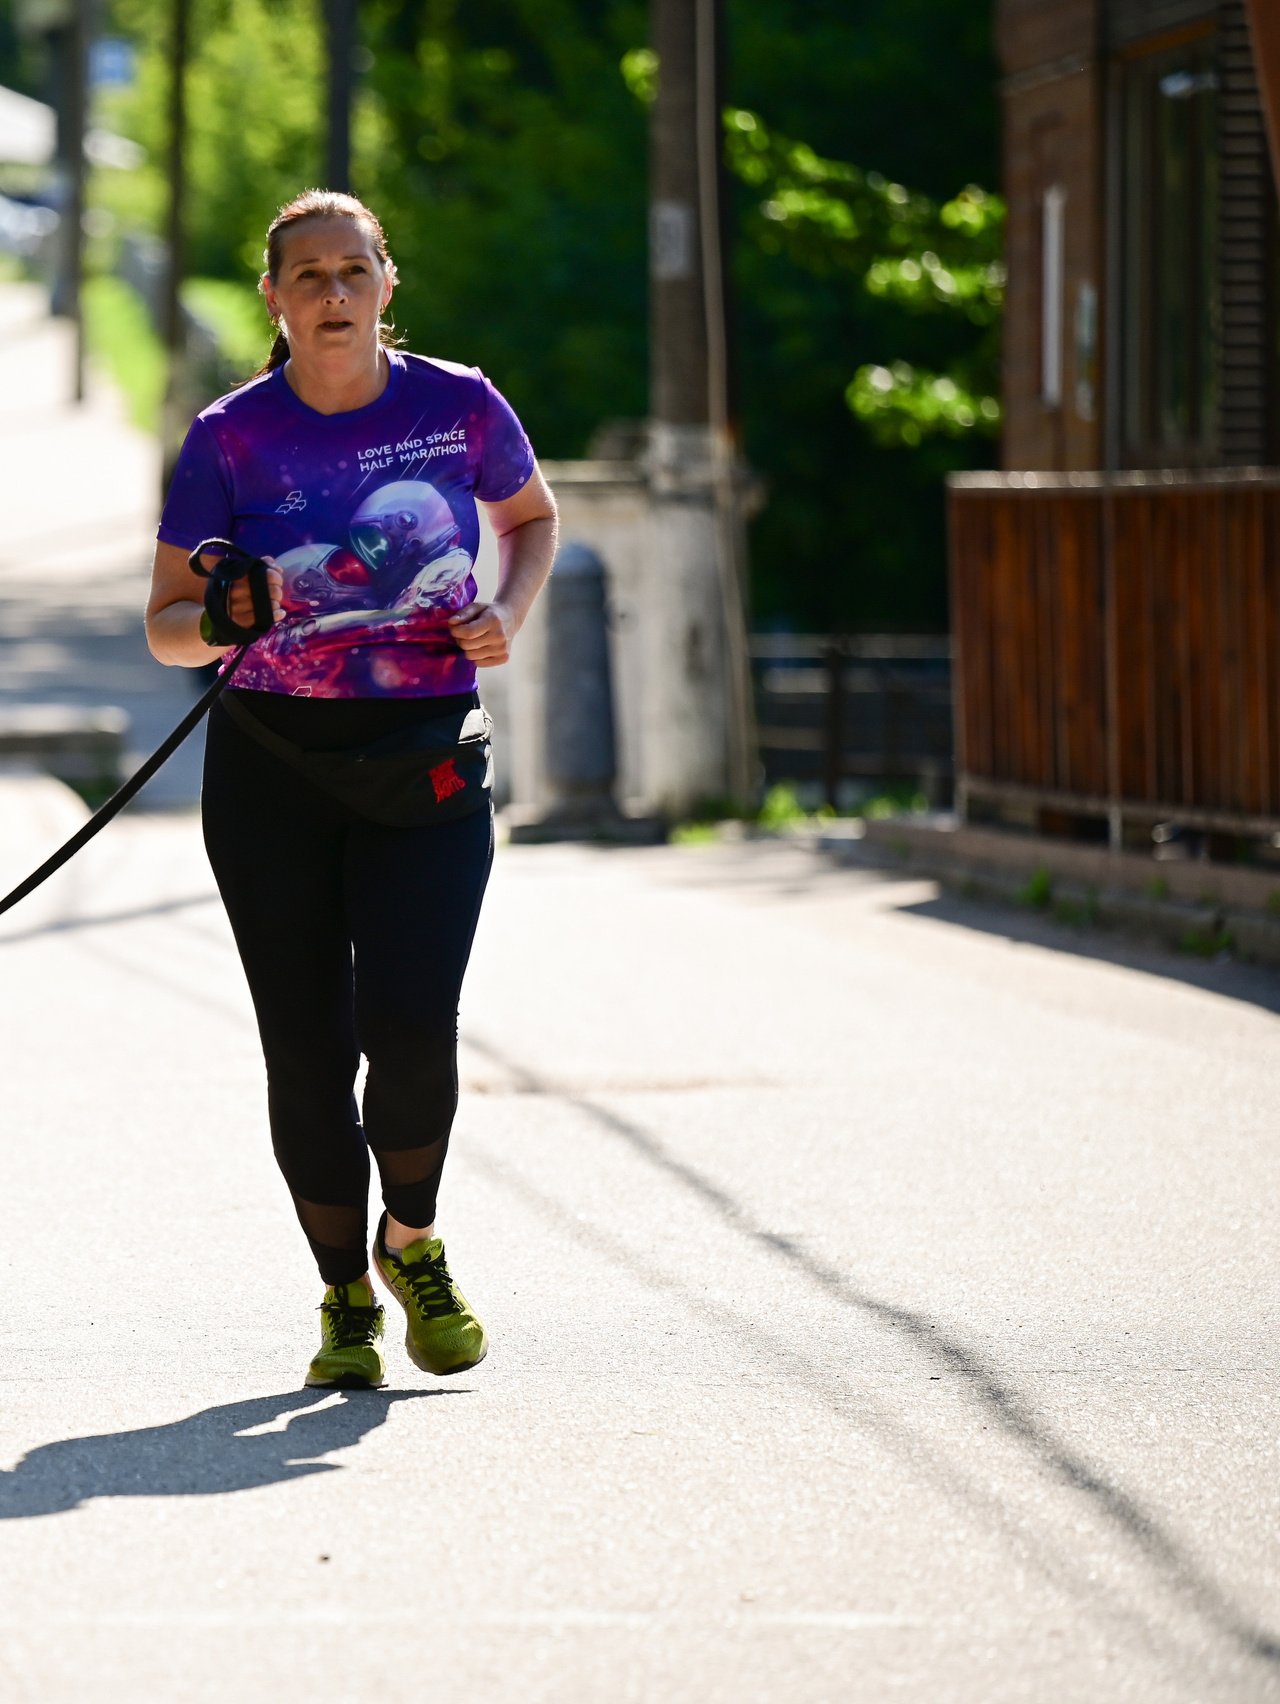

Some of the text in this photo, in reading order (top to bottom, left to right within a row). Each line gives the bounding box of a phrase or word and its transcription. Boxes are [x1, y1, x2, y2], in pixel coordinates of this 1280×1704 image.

[357, 429, 466, 460] LOVE AND SPACE
[360, 443, 467, 472] HALF MARATHON
